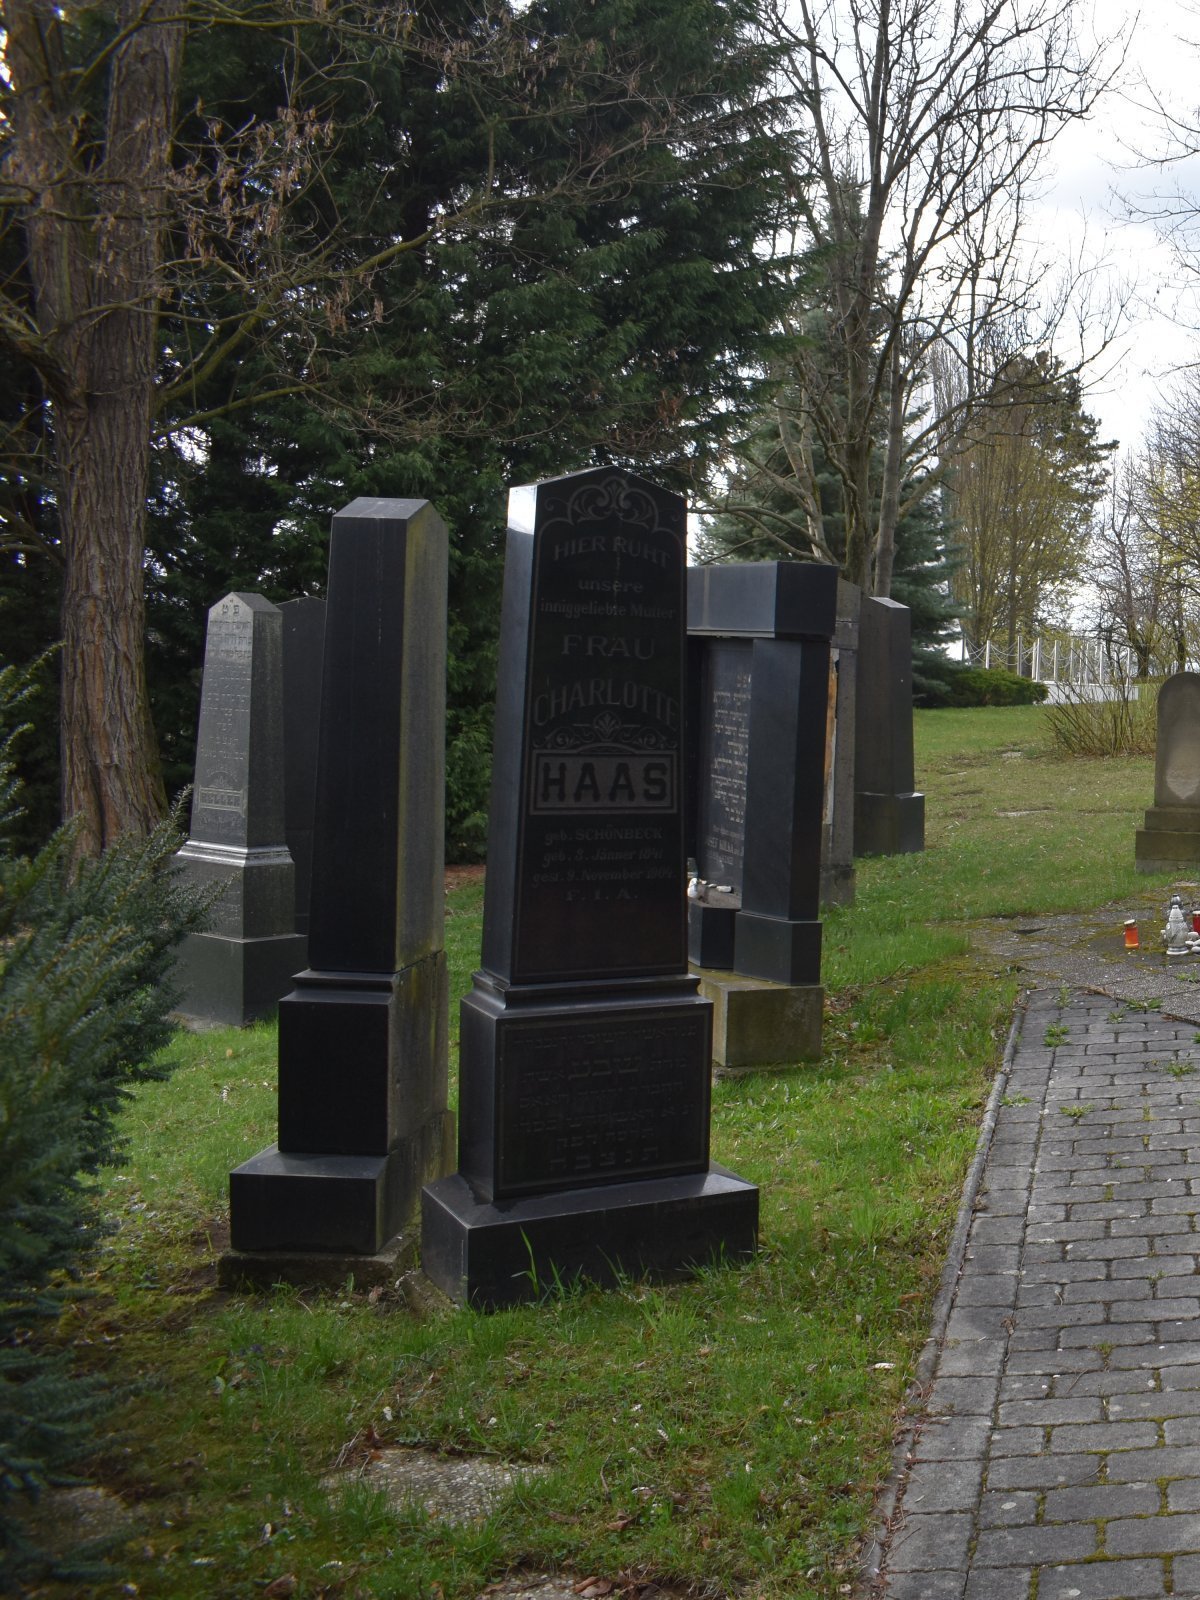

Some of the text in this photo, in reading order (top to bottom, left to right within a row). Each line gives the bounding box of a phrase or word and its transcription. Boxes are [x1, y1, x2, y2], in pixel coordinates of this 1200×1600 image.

[553, 535, 671, 568] HIER RUHT
[577, 579, 645, 593] unsere
[560, 633, 655, 660] FRAU
[533, 677, 679, 732] CHARLOTTE
[541, 761, 668, 803] HAAS
